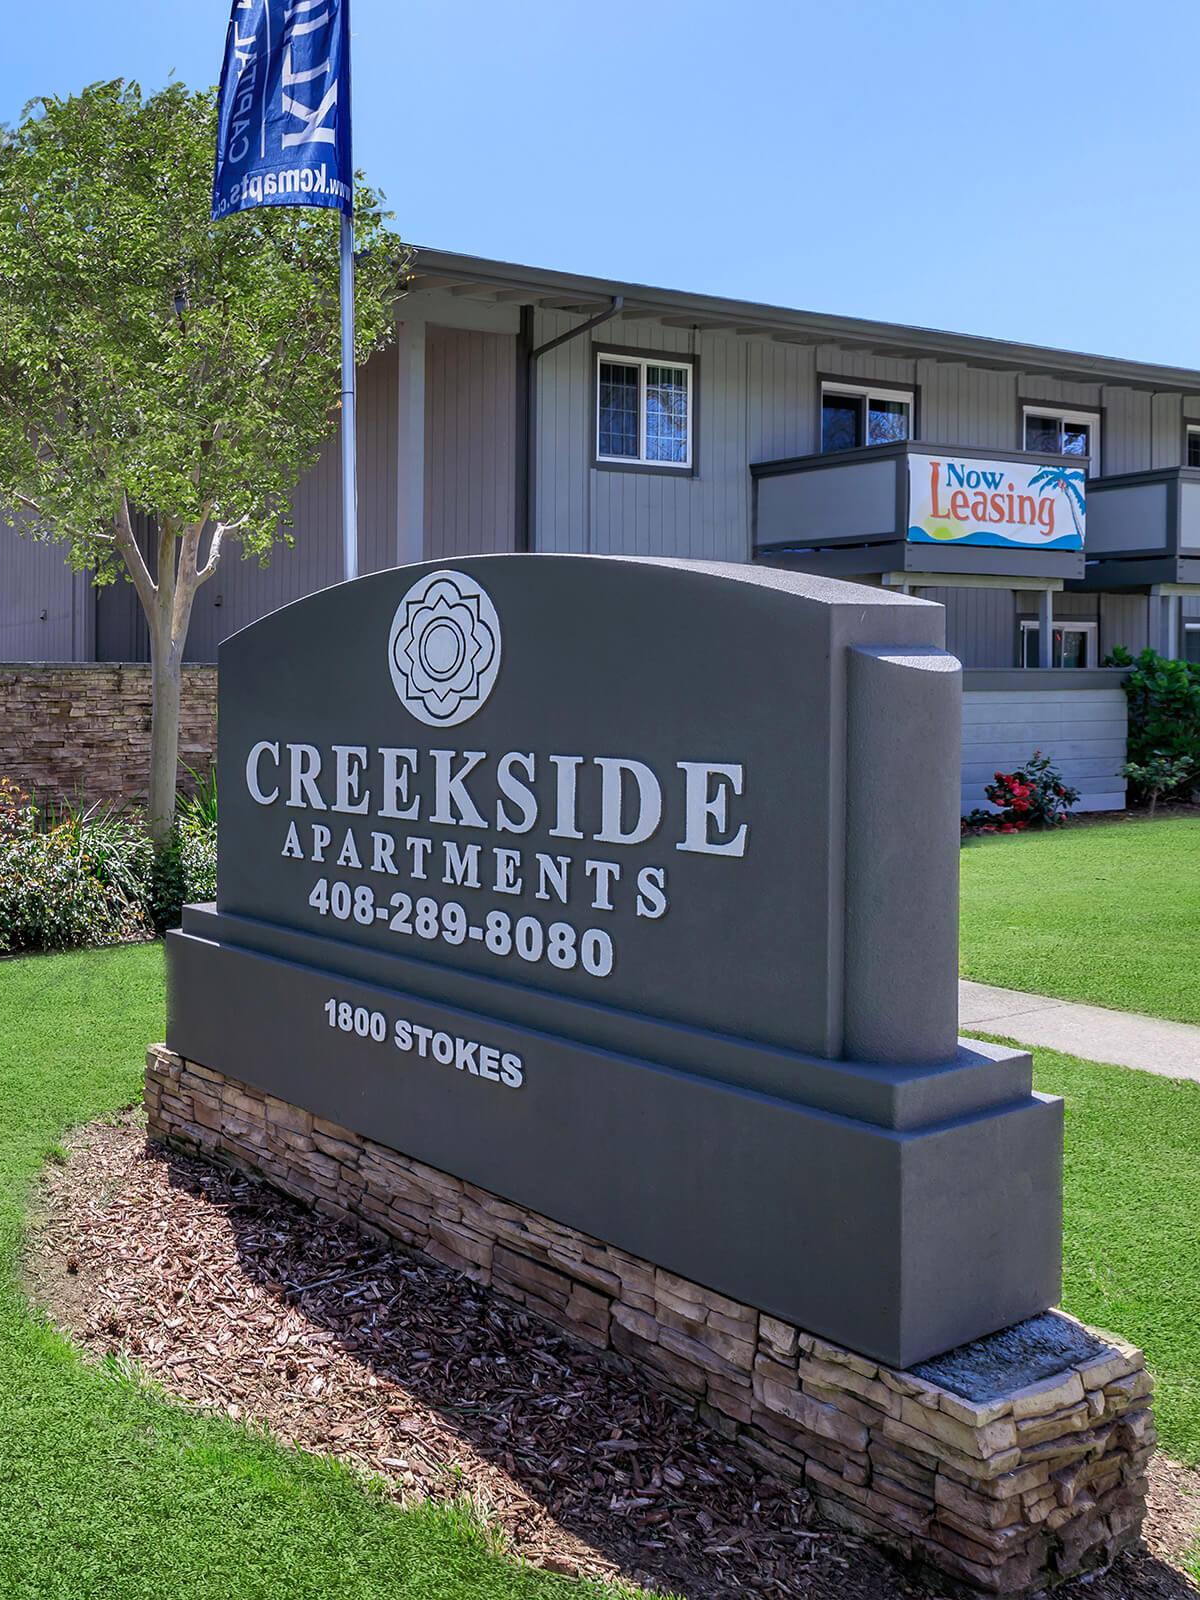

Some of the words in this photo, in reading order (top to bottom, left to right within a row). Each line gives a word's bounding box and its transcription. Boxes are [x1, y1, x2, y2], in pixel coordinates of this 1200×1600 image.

[929, 461, 1056, 537] Leasing
[946, 463, 1005, 490] Now
[246, 740, 749, 858] CREEKSIDE
[281, 820, 668, 920] APARTMENTS
[308, 877, 615, 978] 408-289-8080
[324, 998, 387, 1043] 1800
[394, 1019, 525, 1090] STOKES
